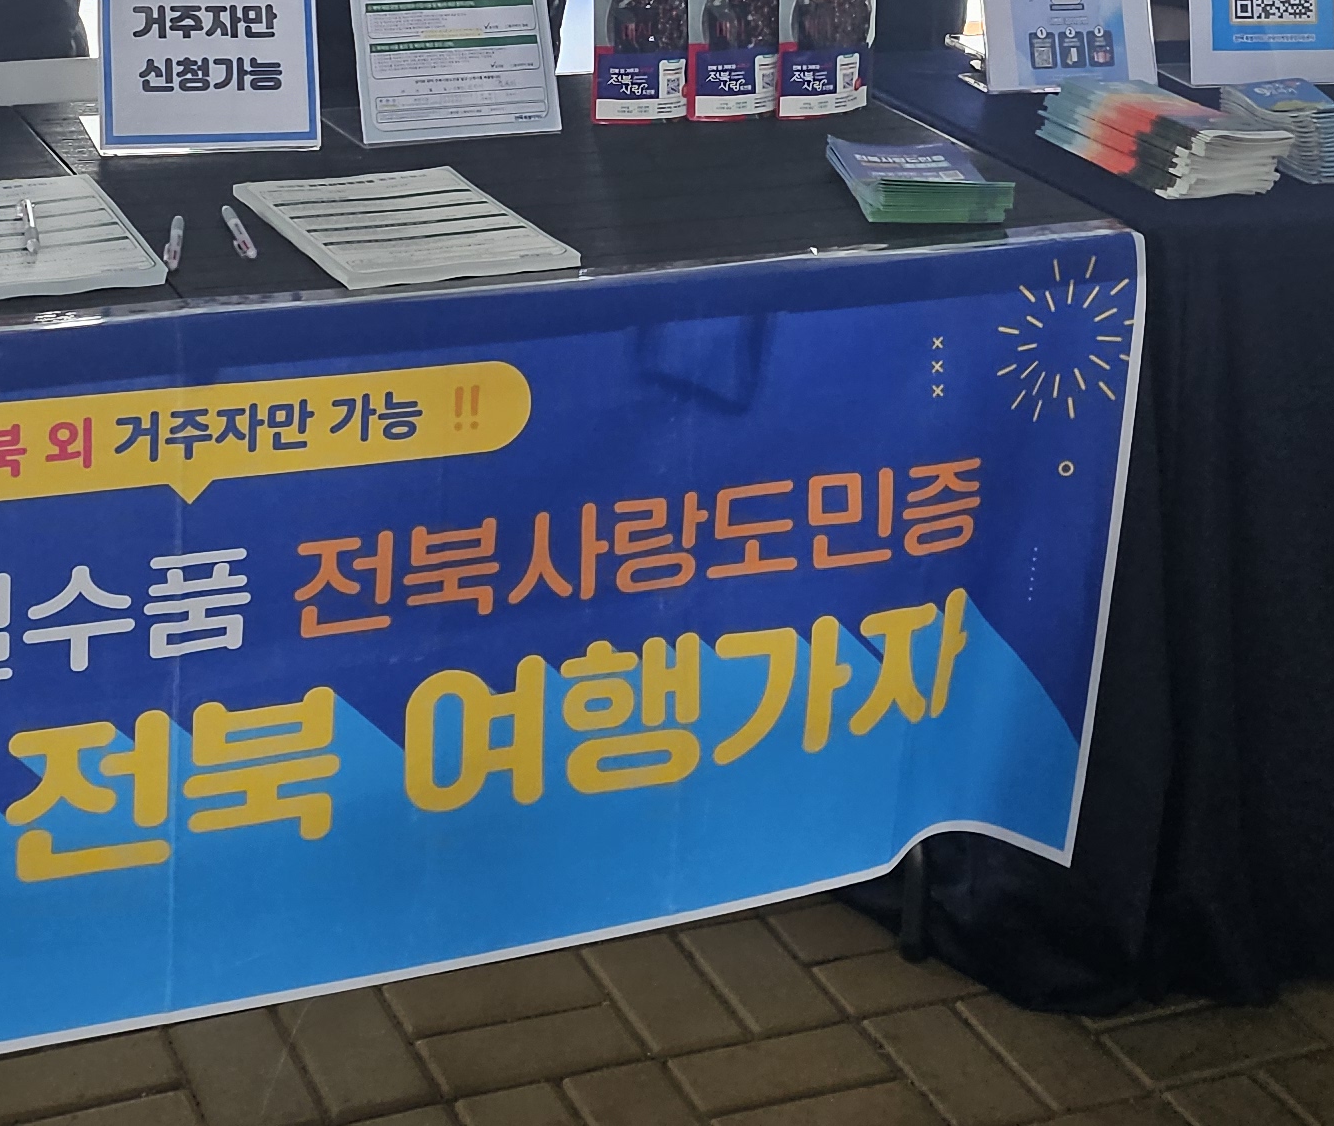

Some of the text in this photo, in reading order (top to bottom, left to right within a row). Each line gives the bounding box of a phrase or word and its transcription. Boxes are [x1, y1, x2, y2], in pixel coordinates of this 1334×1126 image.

[133, 4, 278, 40] 거주자만
[139, 56, 283, 94] 신청가능
[45, 417, 94, 469] 외
[113, 399, 316, 464] 거주자만
[329, 390, 424, 442] 가능
[294, 456, 984, 640] 전북사랑도민증
[5, 685, 341, 884] 전북
[404, 587, 969, 813] 여행가자
